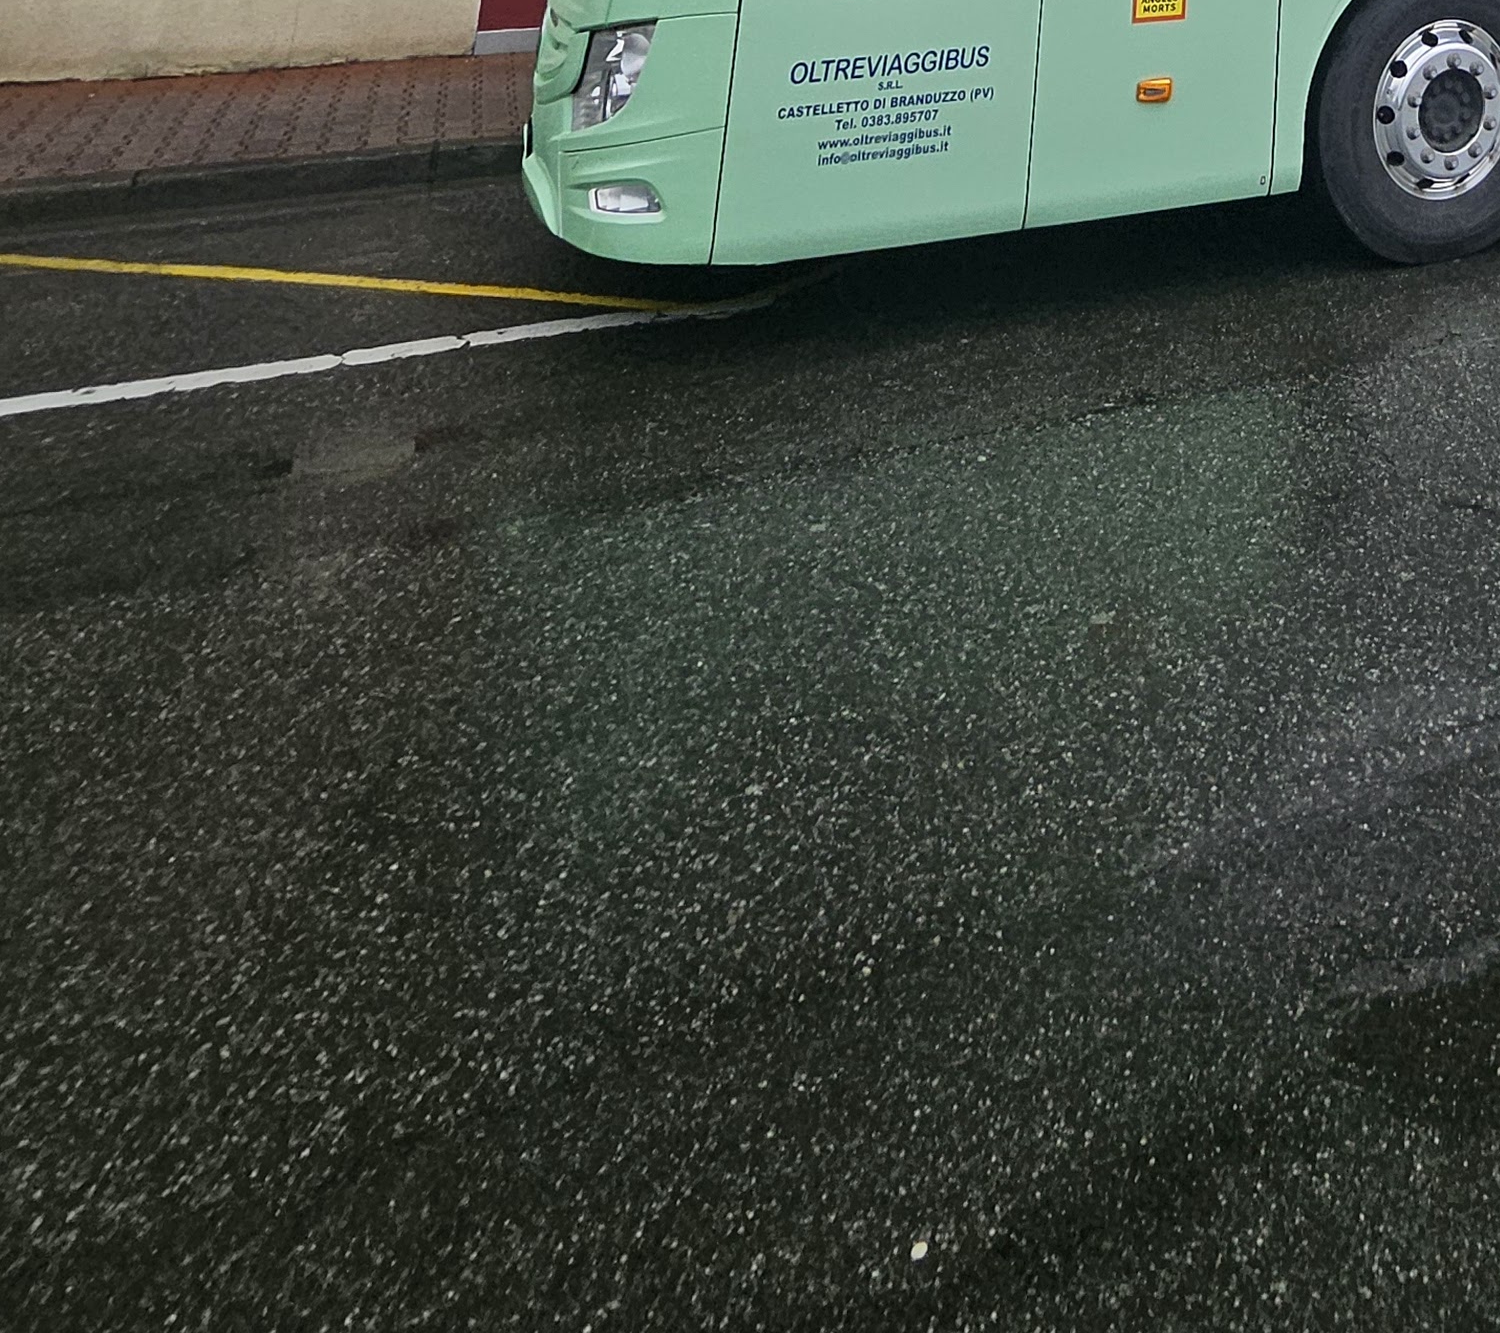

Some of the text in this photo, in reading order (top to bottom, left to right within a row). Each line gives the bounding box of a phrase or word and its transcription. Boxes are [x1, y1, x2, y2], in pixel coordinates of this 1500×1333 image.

[1142, 2, 1177, 14] MORTS
[789, 45, 991, 85] OLTREVIAGGIBUS
[877, 79, 904, 92] S.R.L.
[777, 86, 995, 120] CASTELLETTO DI BRANDUZZO (PV)
[834, 109, 940, 131] Tel. 0383.895707
[817, 125, 952, 151] www.oltreviaggibus.it
[817, 140, 950, 167] info@oltreviaggibus.it
